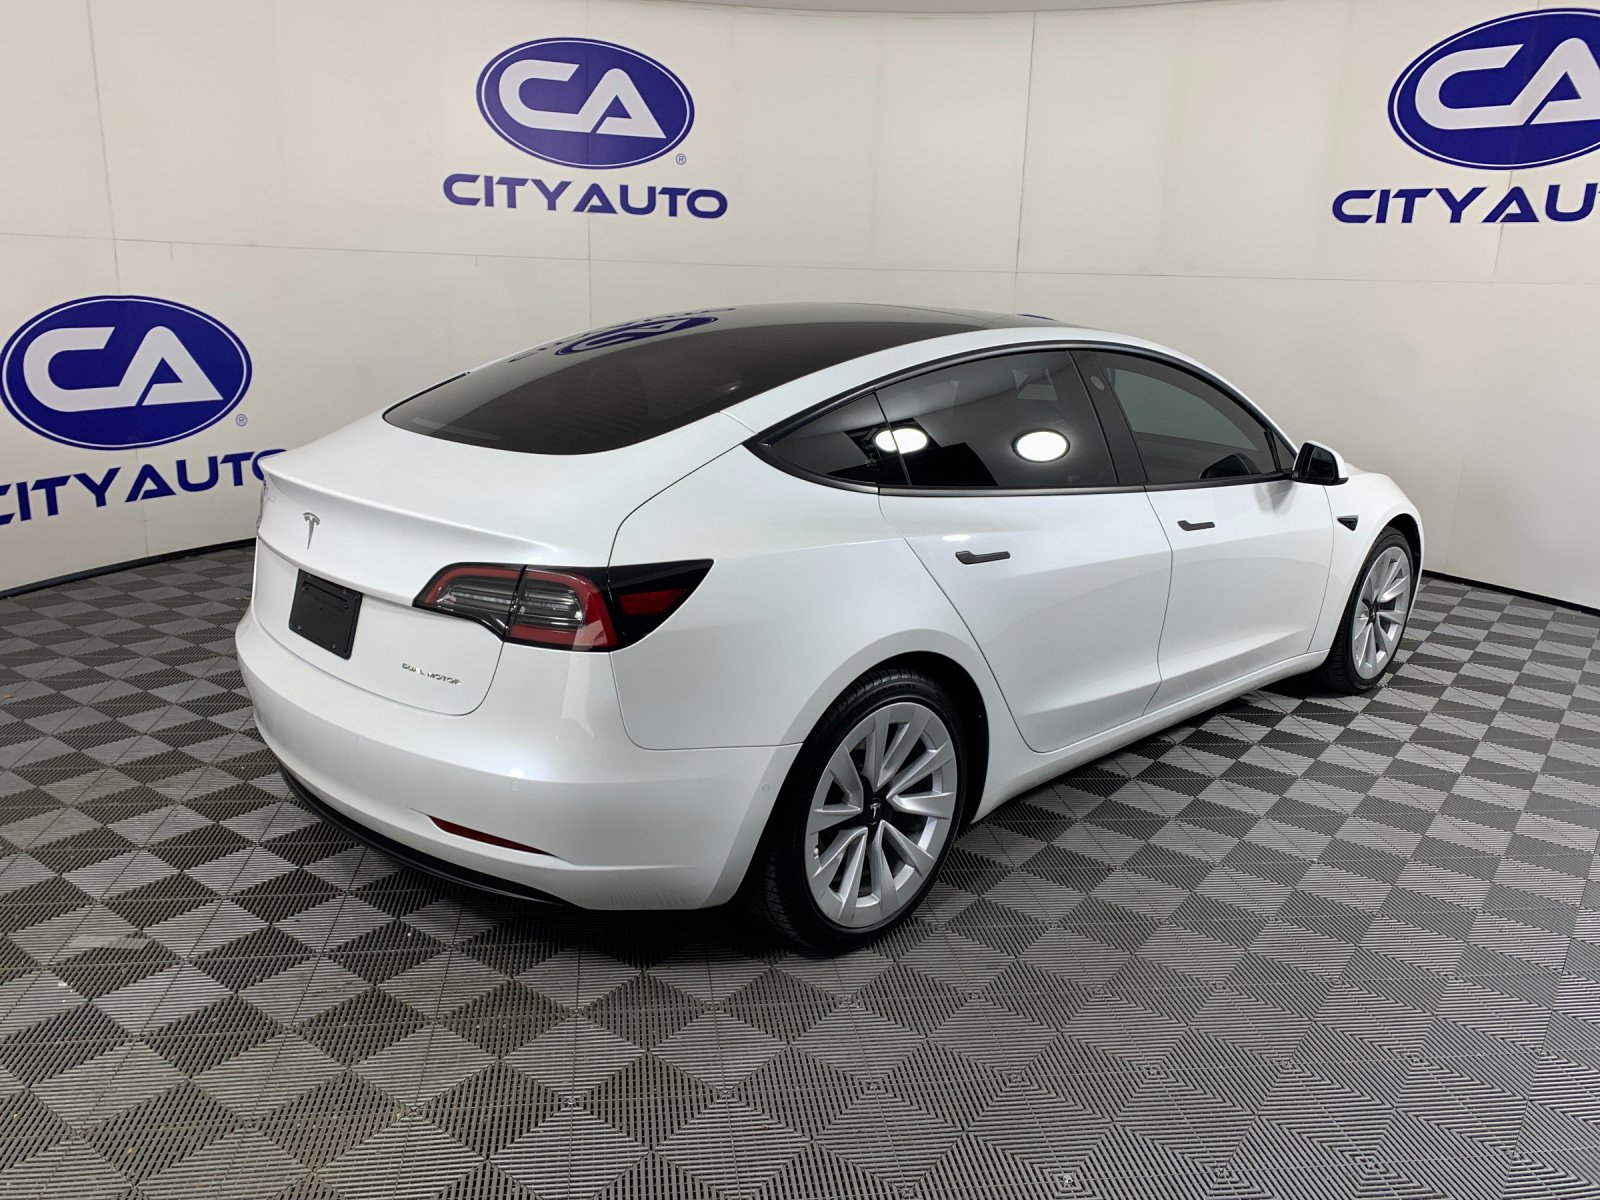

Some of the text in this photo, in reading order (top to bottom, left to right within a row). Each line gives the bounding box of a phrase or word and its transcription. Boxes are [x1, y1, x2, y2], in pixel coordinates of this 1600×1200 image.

[499, 59, 667, 139] CA
[1415, 37, 1600, 130] CA
[1481, 182, 1600, 224] AU
[23, 326, 224, 413] CA
[427, 671, 461, 685] MOTOR
